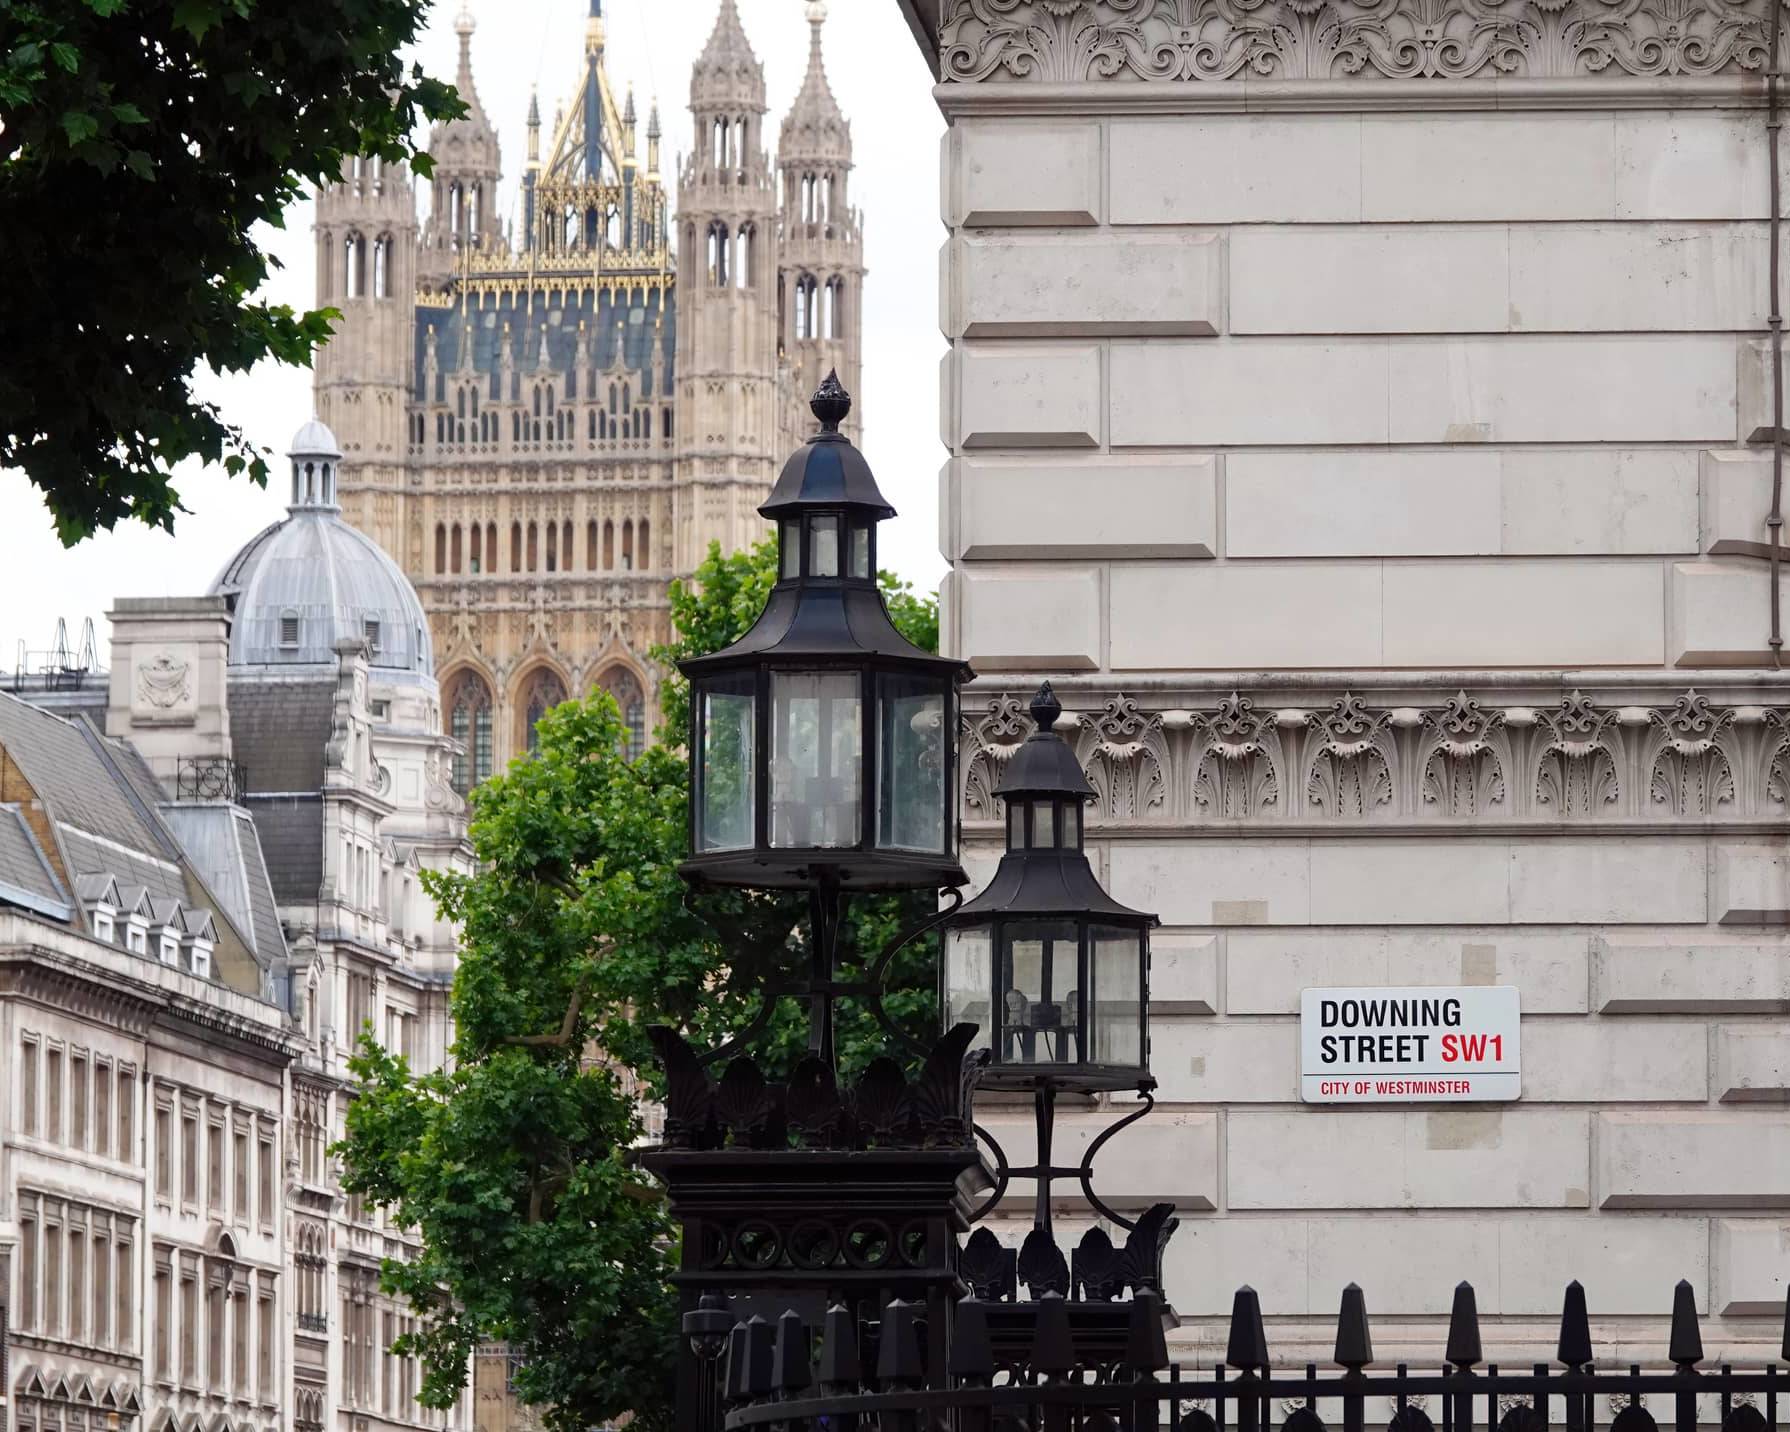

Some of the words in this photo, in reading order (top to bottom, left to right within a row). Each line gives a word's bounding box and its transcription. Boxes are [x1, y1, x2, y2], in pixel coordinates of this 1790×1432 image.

[1320, 998, 1461, 1028] DOWNING
[1320, 1035, 1430, 1064] STREET
[1441, 1034, 1503, 1063] SW1
[1321, 1081, 1350, 1095] CITY
[1354, 1081, 1371, 1095] OF
[1375, 1080, 1470, 1094] WESTMINSTER
